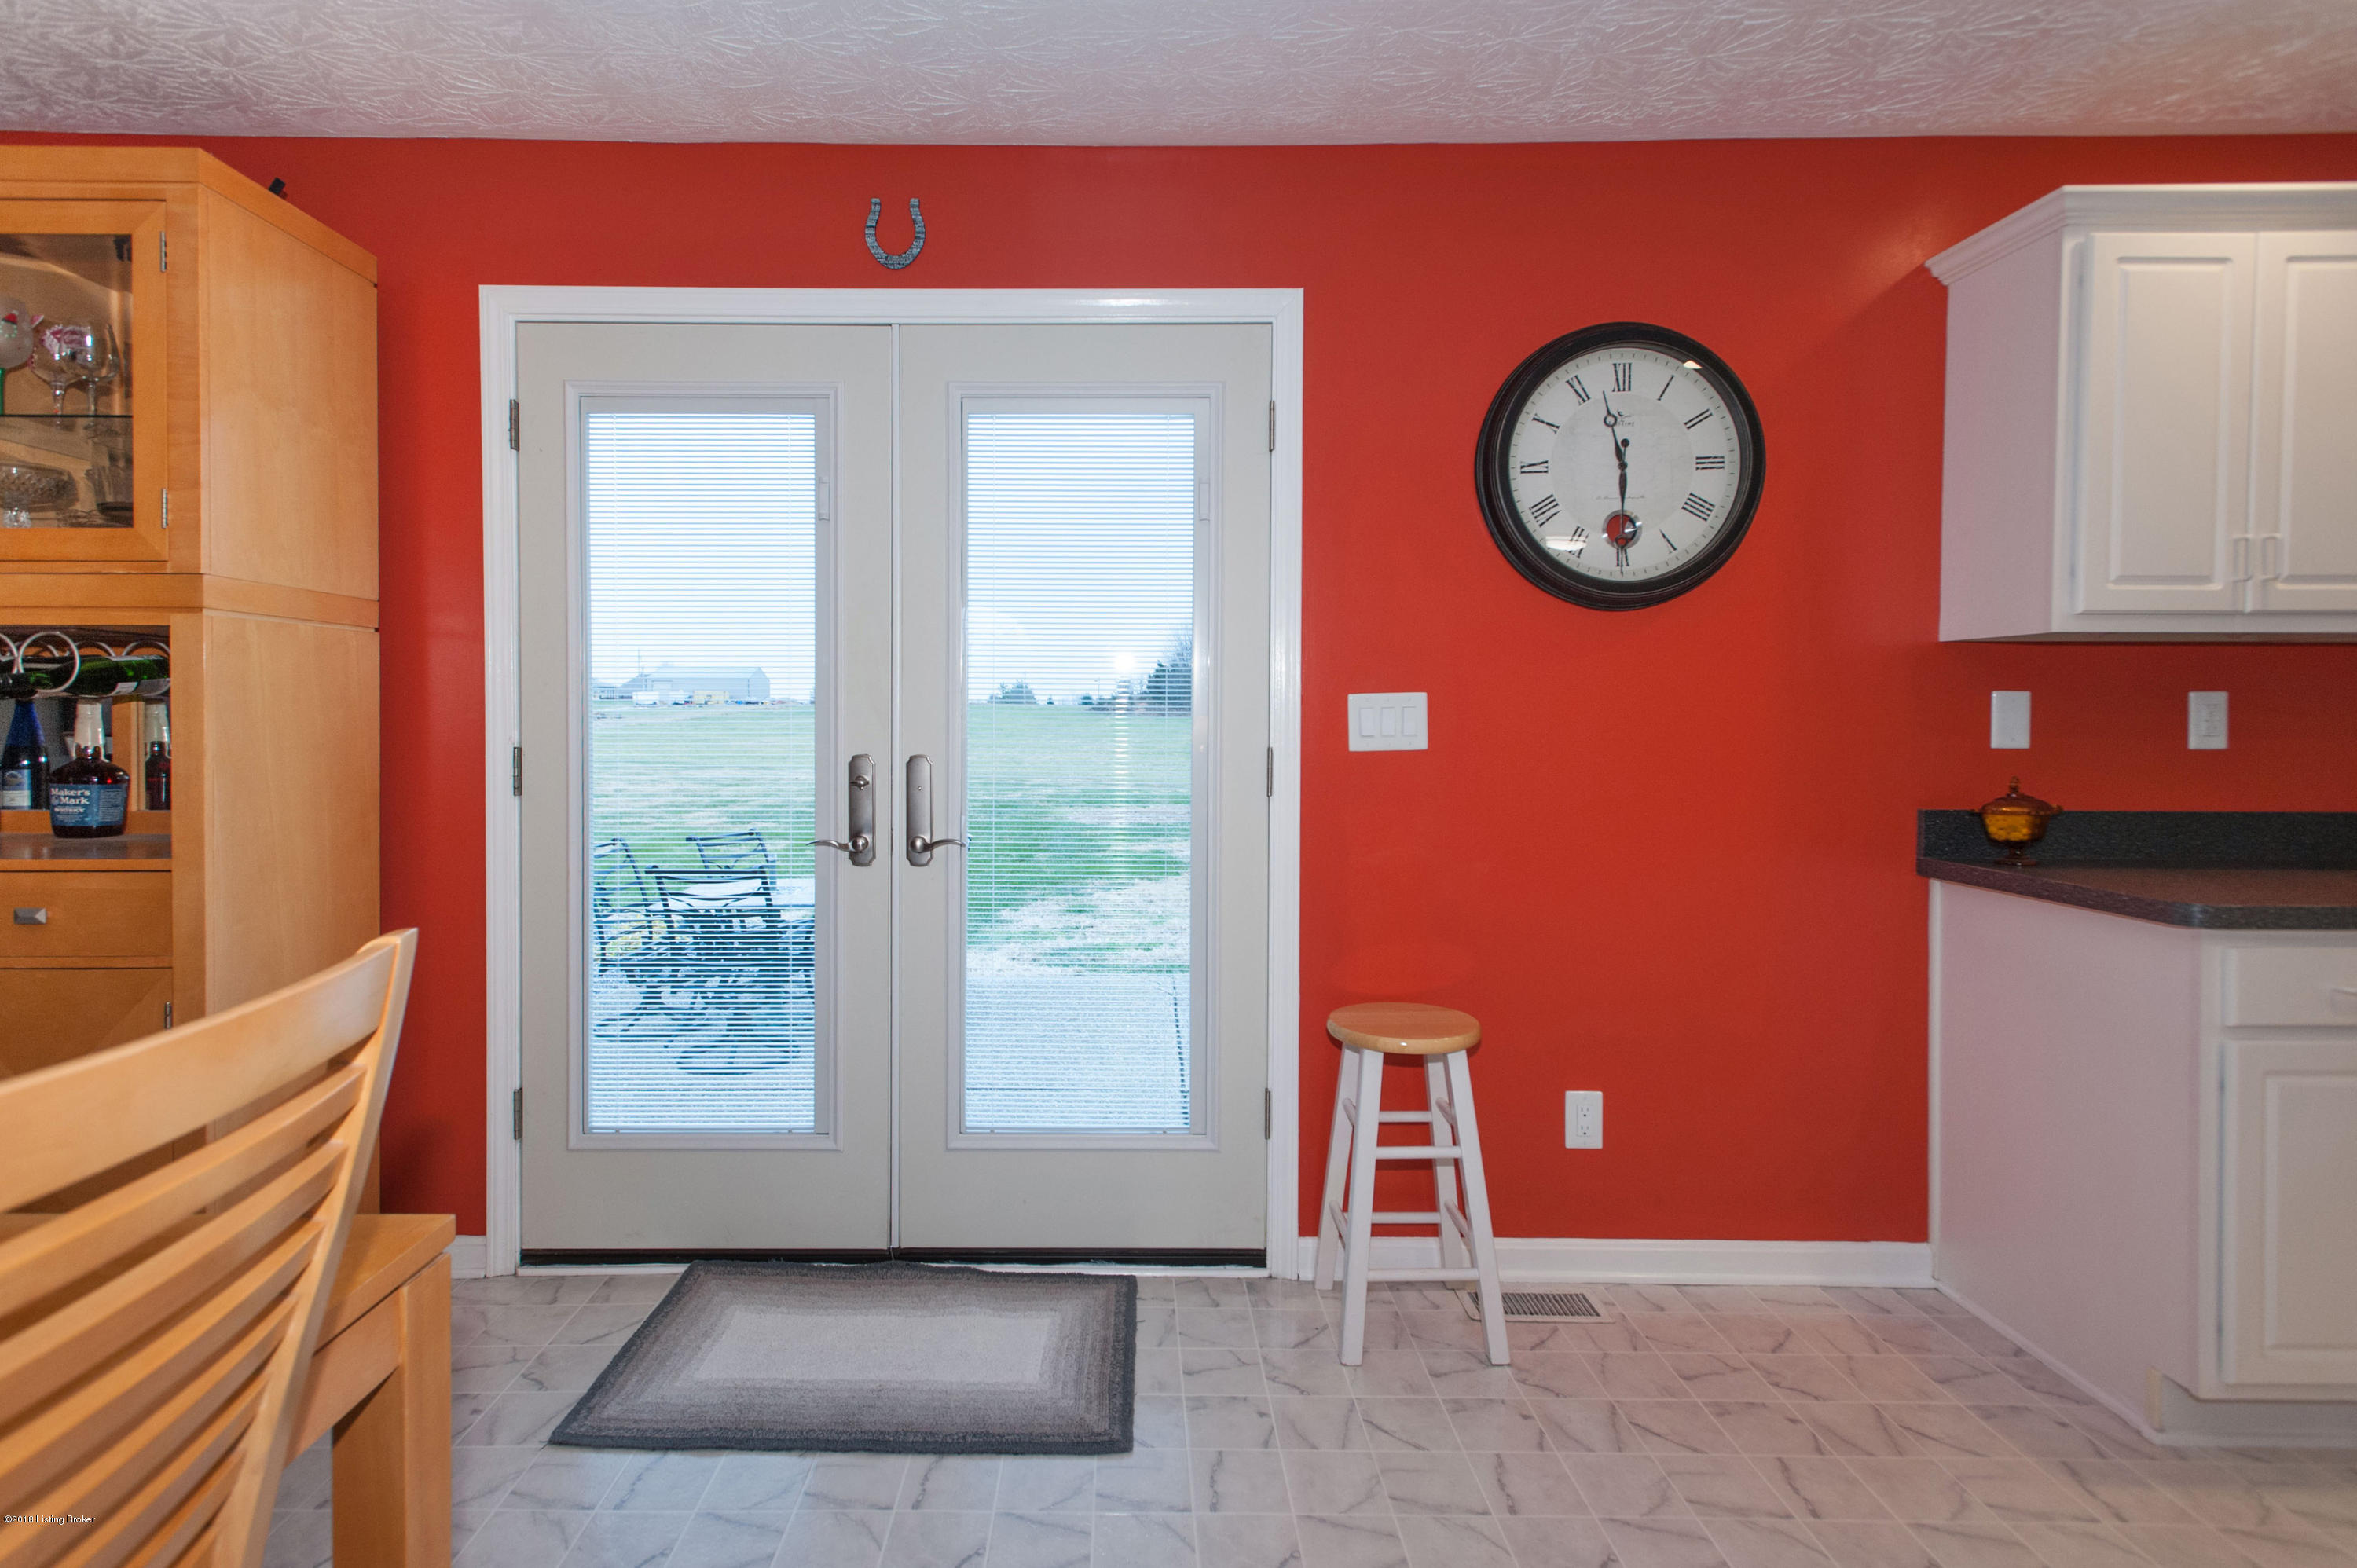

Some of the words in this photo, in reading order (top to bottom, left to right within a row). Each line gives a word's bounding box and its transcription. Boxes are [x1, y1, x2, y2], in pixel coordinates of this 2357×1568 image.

[1565, 374, 1591, 405] XI
[1611, 362, 1633, 393] XII
[1657, 374, 1675, 401] I
[1683, 408, 1714, 430] II
[1520, 460, 1549, 474] IX
[1695, 456, 1725, 471] III
[1681, 492, 1716, 522] IIII
